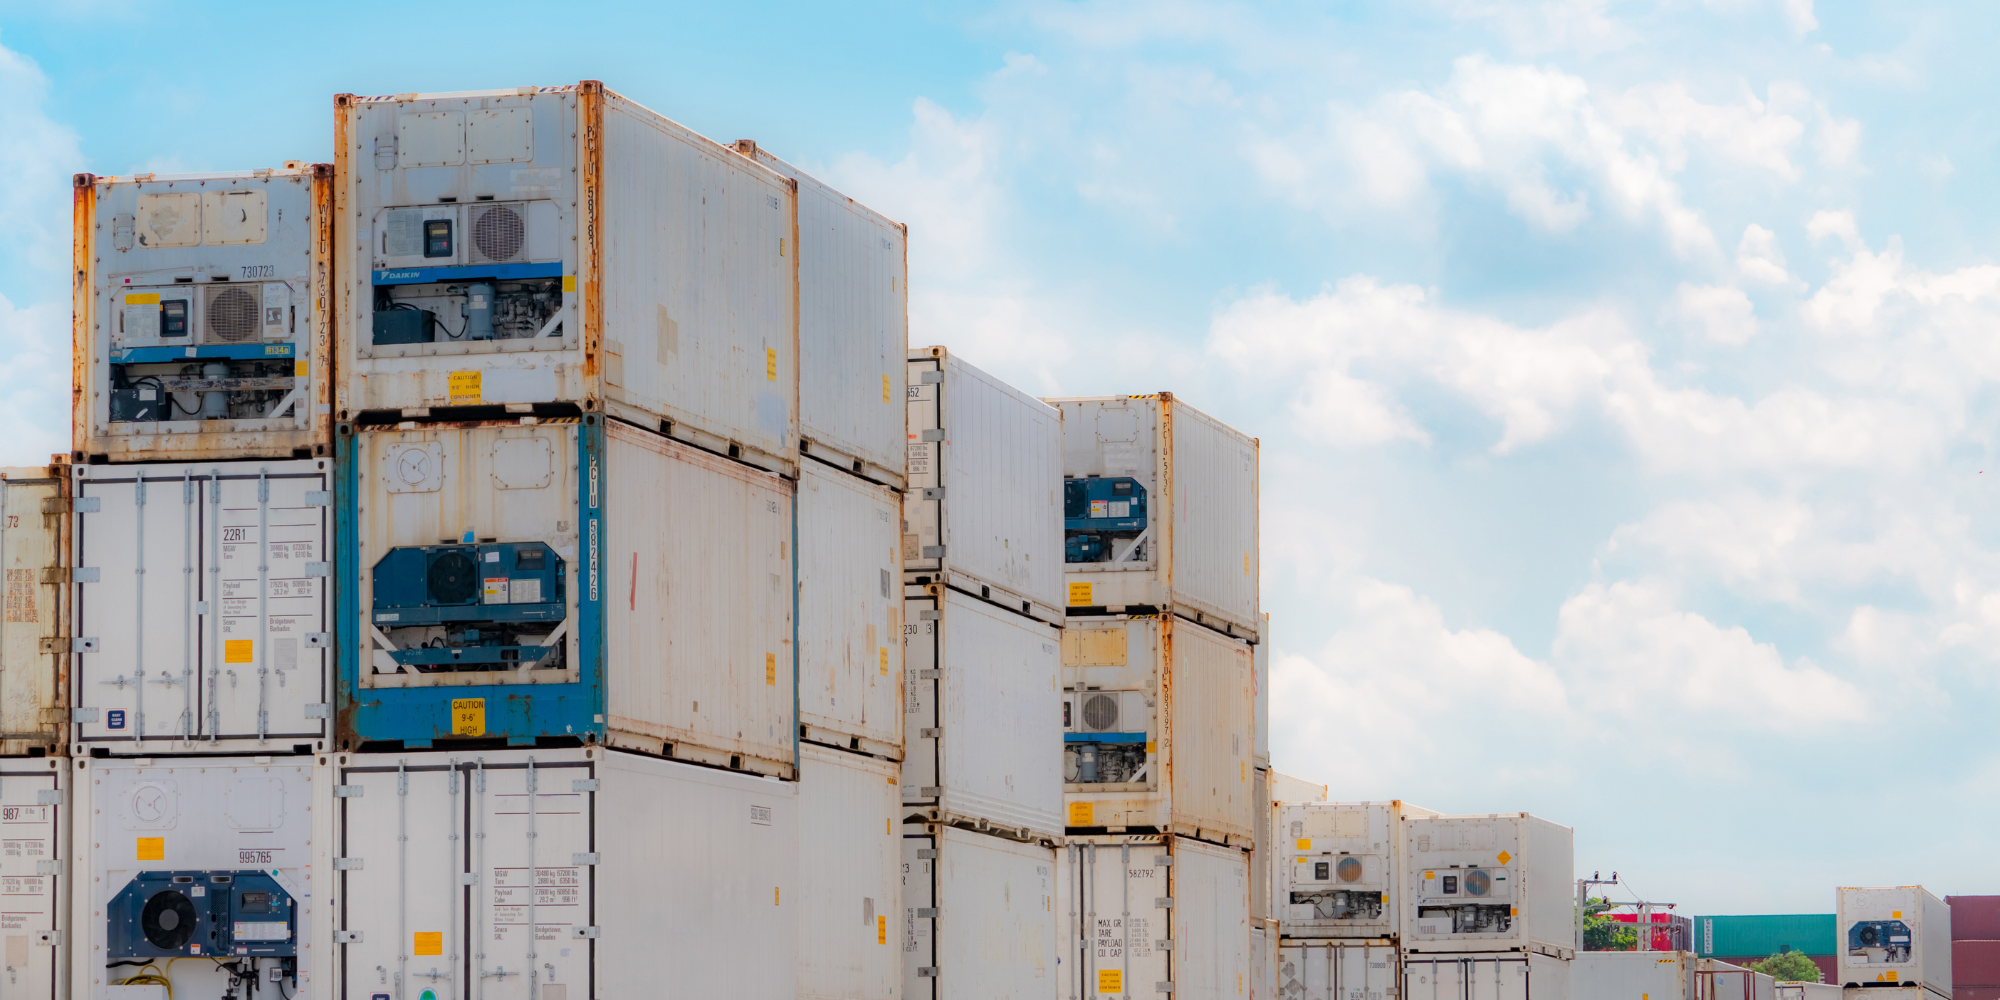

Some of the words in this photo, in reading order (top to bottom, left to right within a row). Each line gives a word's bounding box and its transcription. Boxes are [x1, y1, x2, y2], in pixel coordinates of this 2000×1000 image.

[241, 265, 275, 279] 730723
[223, 528, 246, 541] 22R1
[223, 582, 240, 590] Payload
[453, 700, 484, 710] CAUTION
[460, 726, 478, 734] HIGH
[3, 808, 19, 820] 987
[240, 851, 272, 863] 995765
[1129, 869, 1154, 878] 582792
[1098, 929, 1112, 937] TARE
[1098, 939, 1122, 947] PAYLOAD
